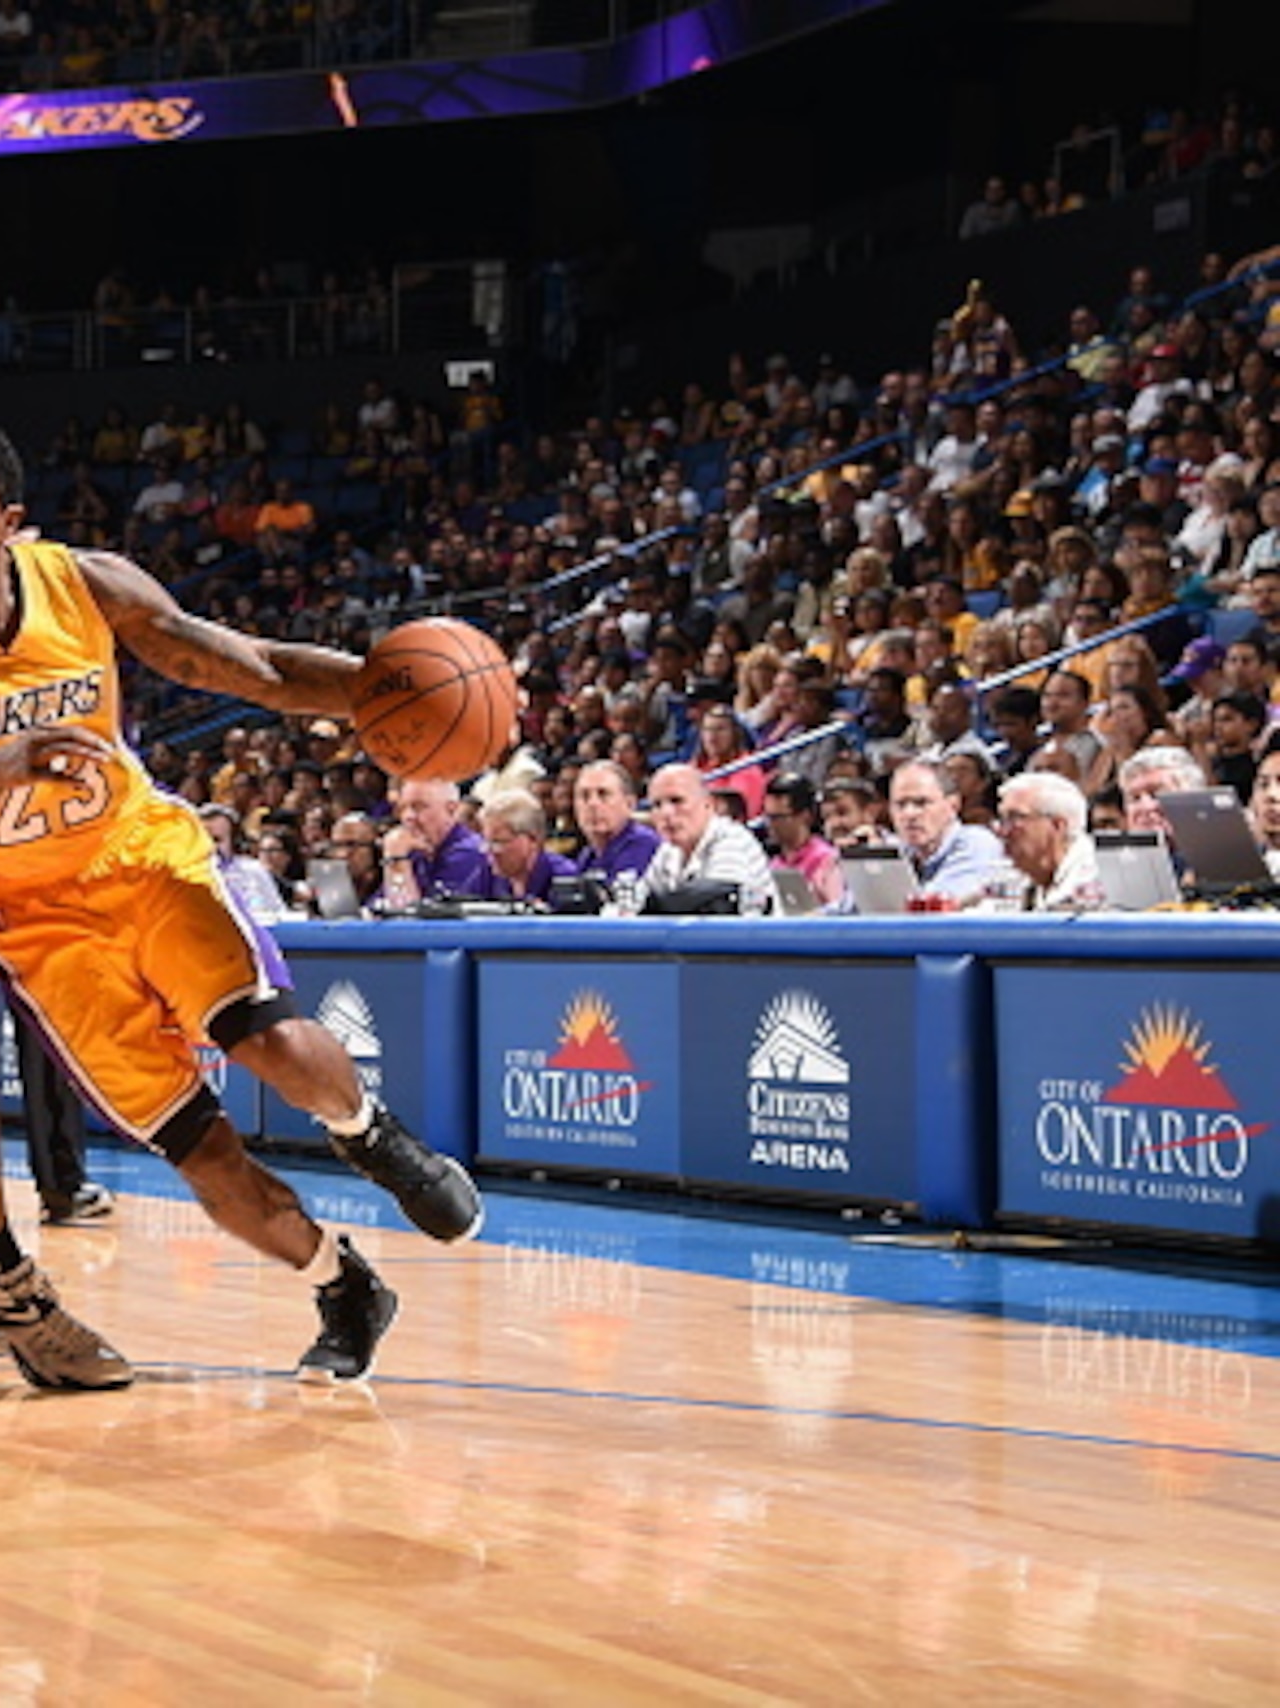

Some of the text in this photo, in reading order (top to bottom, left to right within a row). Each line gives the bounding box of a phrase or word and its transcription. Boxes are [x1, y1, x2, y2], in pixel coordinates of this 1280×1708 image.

[503, 1066, 639, 1127] ONTARIO
[1038, 1079, 1103, 1103] CITY OF
[750, 1140, 850, 1174] ARENA
[1035, 1100, 1248, 1180] ONTARIO
[1040, 1170, 1245, 1206] SOUTHERN CALIFORNIA
